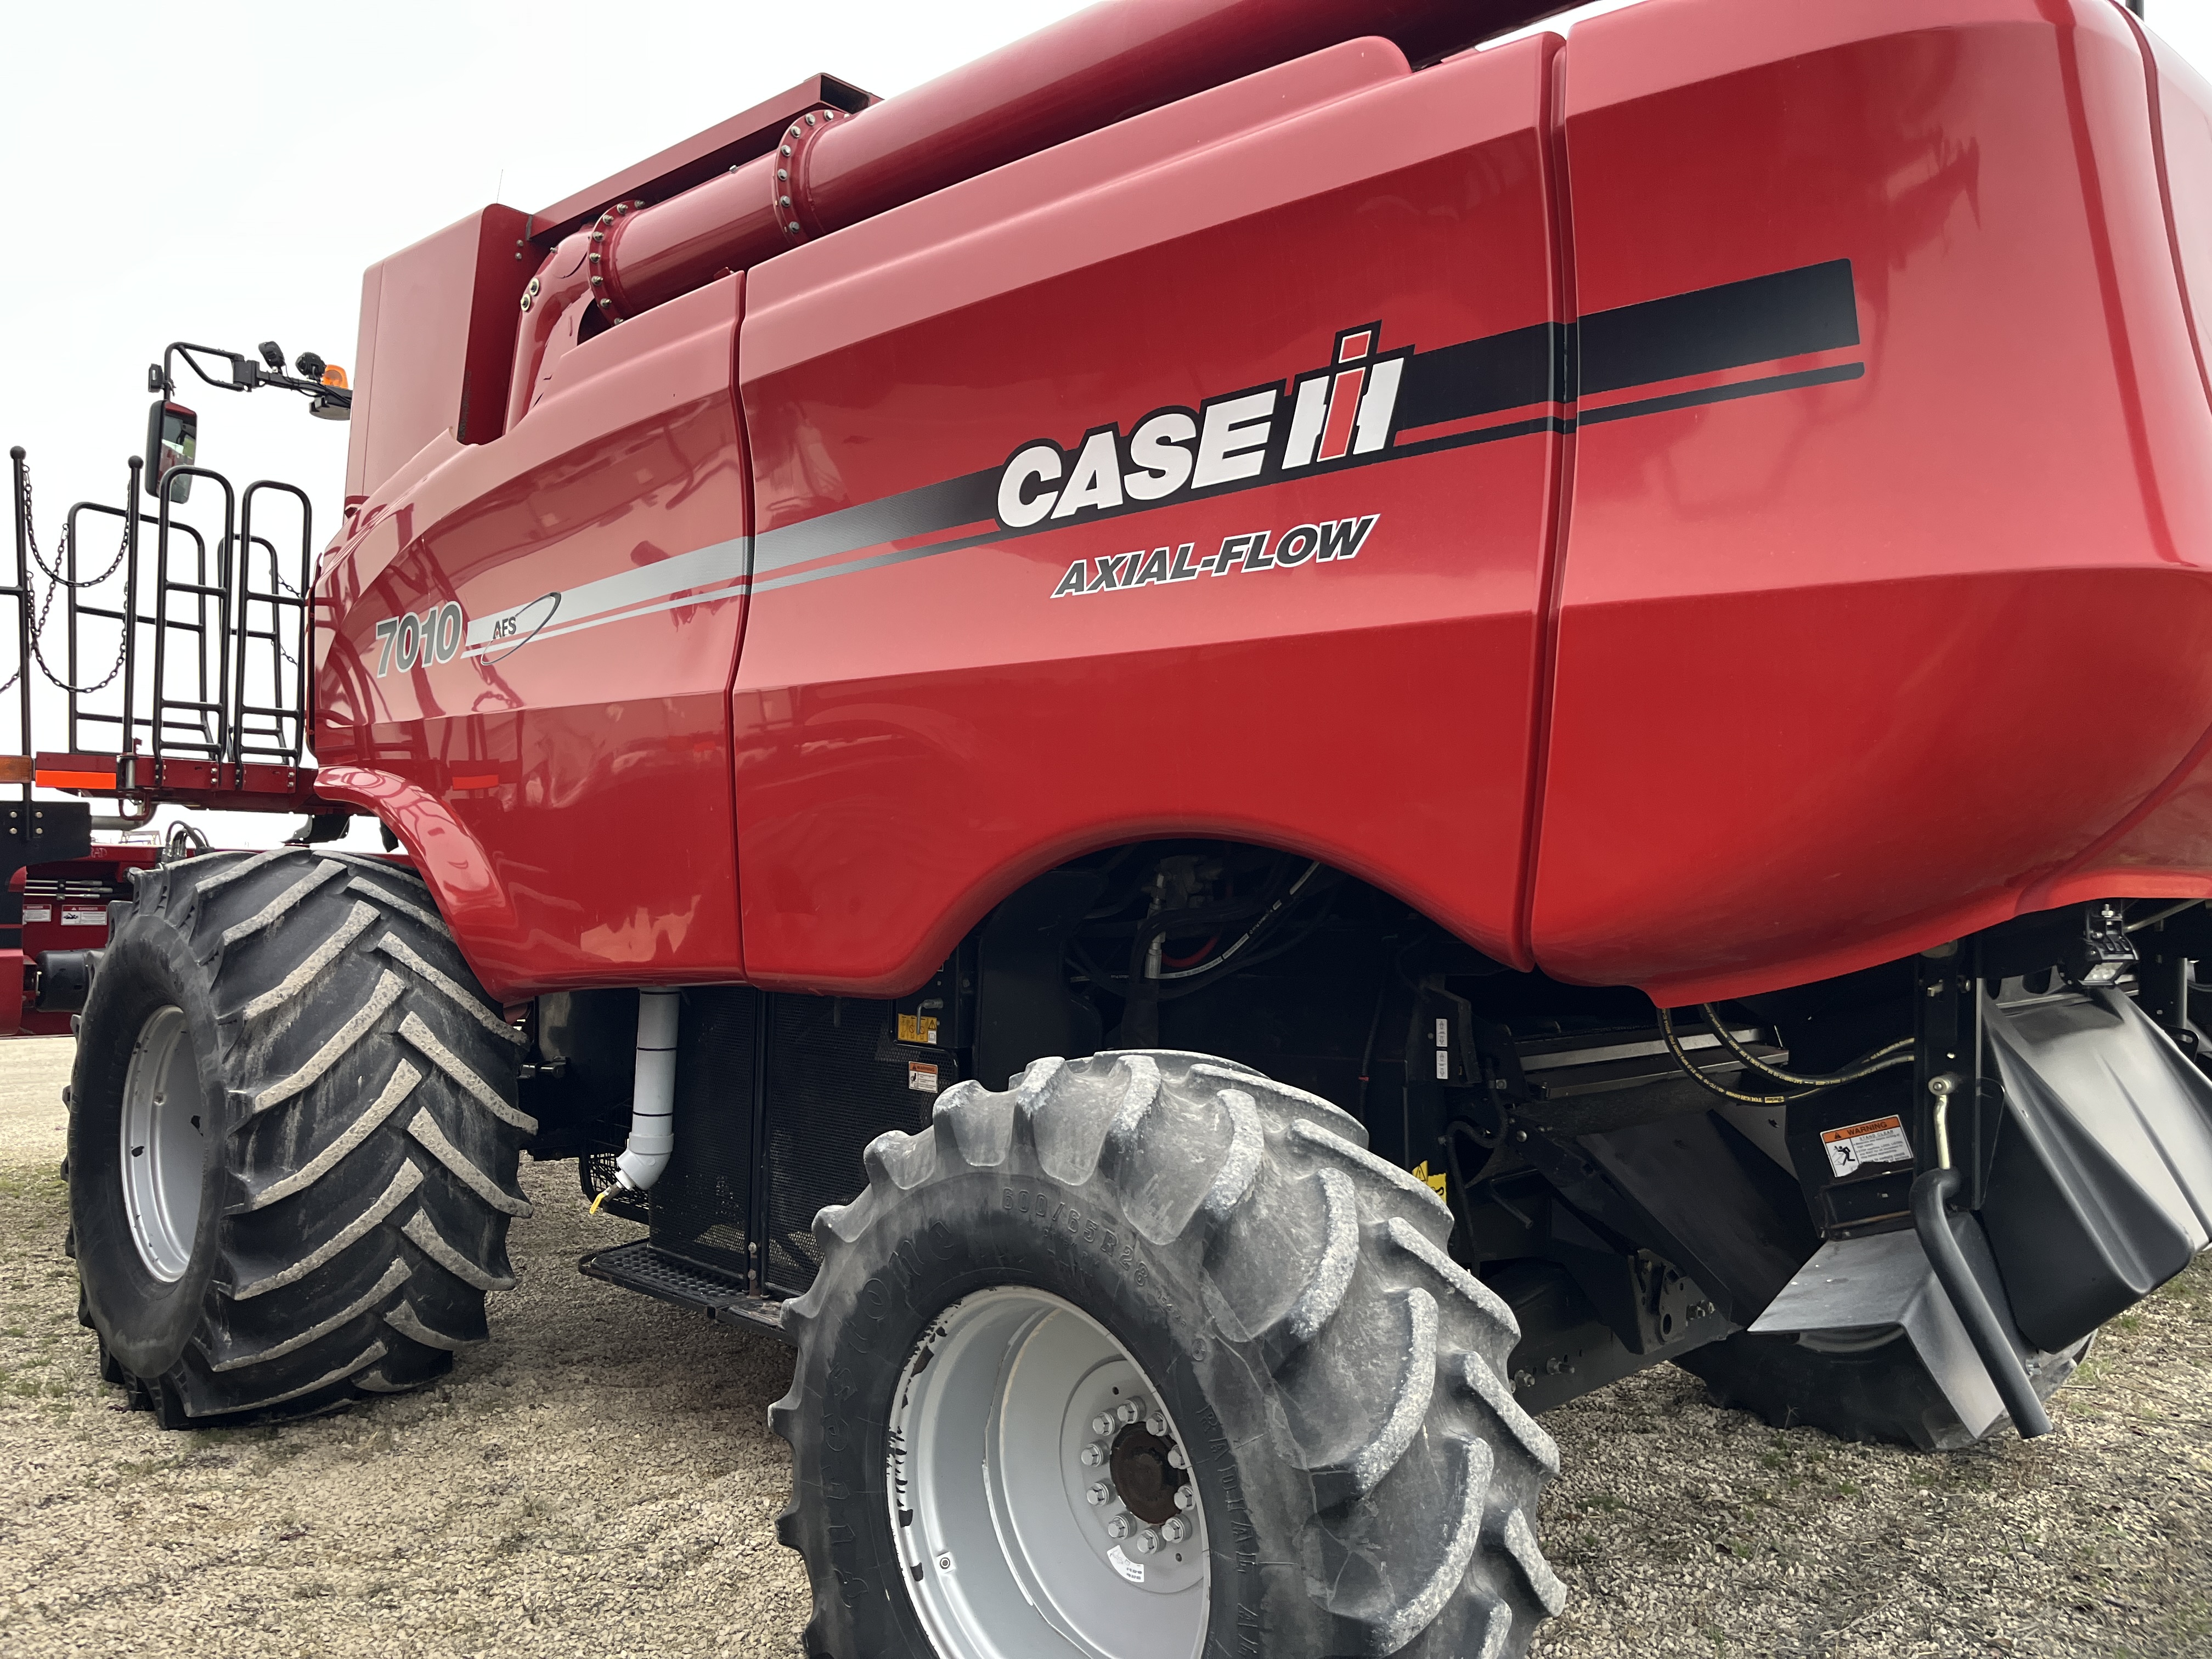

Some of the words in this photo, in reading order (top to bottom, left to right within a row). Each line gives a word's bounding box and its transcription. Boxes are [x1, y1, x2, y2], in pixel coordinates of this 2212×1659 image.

[996, 388, 1277, 528] CASE
[1050, 514, 1380, 599] AXIAL-FLOW
[376, 601, 463, 679] 7010
[492, 616, 517, 640] AFS
[1847, 1121, 1887, 1136] WARNING
[1859, 1133, 1876, 1142] STAND
[1195, 1404, 1257, 1573] RADIAL
